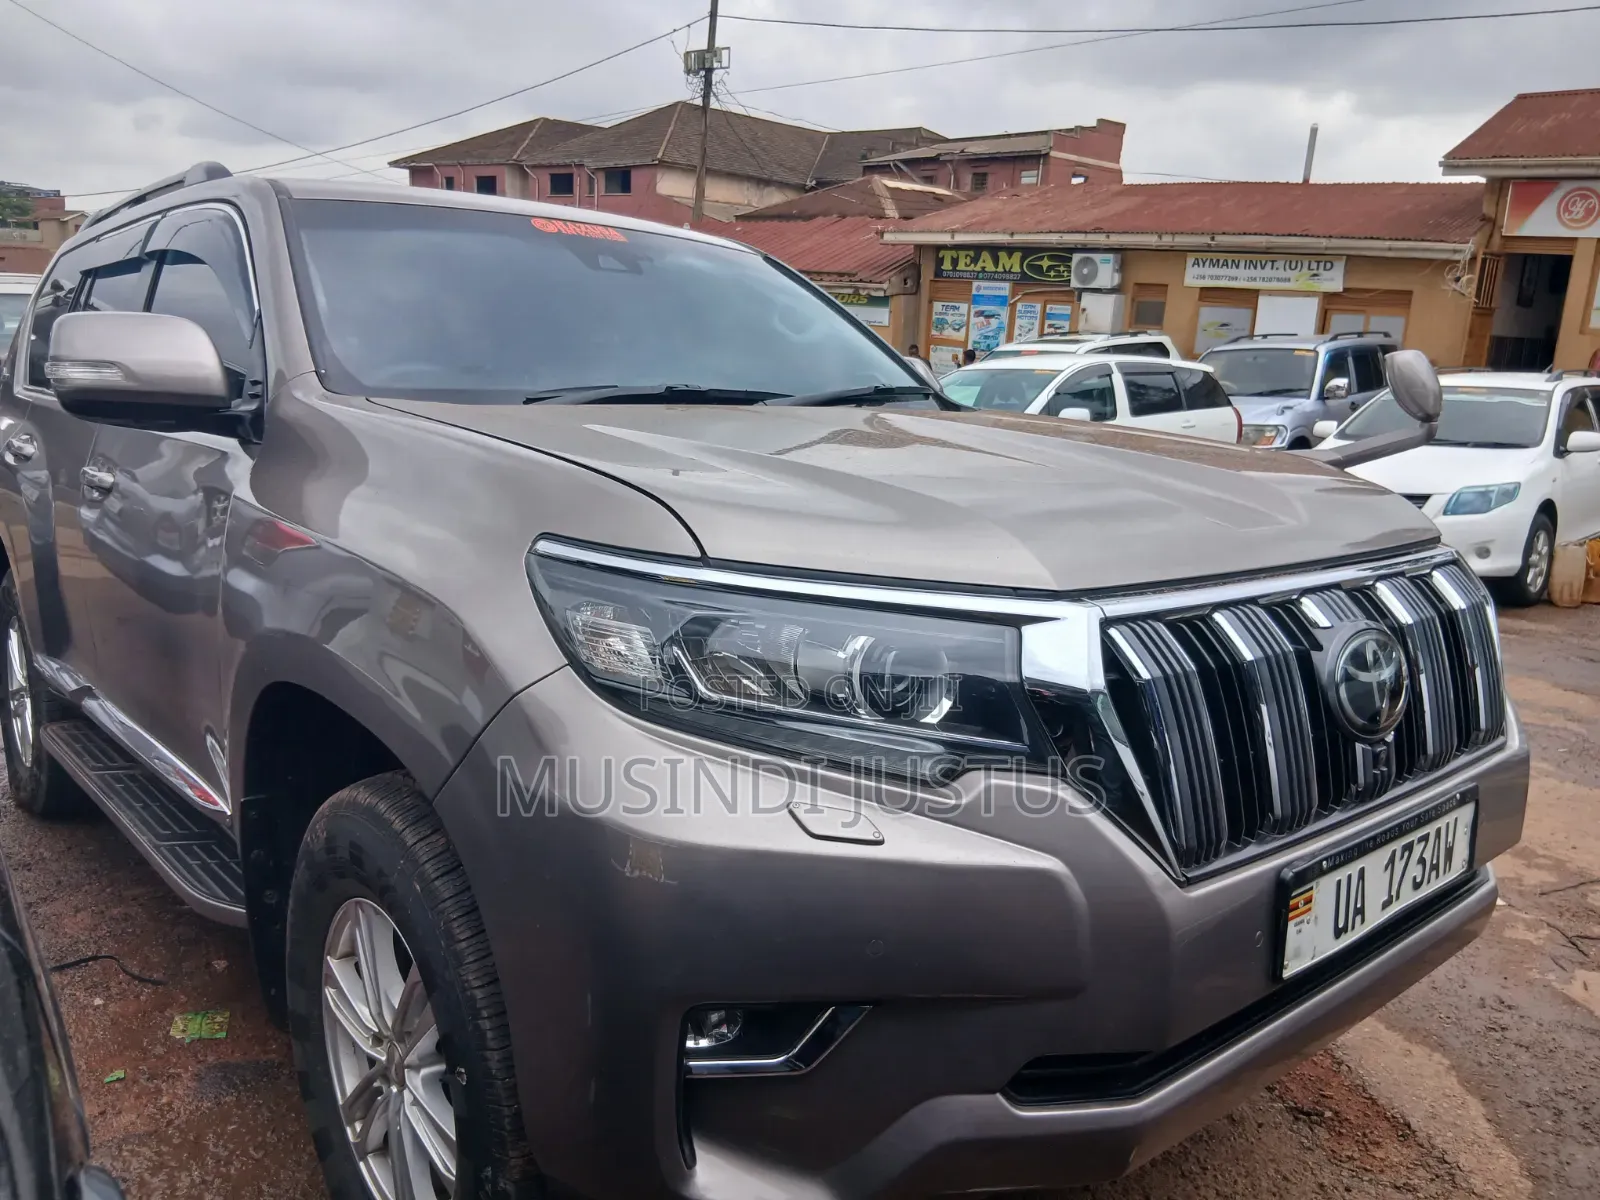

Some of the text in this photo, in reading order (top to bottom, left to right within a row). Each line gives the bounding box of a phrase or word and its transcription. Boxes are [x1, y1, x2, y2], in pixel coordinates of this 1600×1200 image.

[938, 250, 1023, 273] TEAM
[1192, 257, 1334, 273] AYMAN INVT. (U) LTD
[941, 304, 960, 312] TEAM
[1333, 816, 1459, 940] UA 173AW
